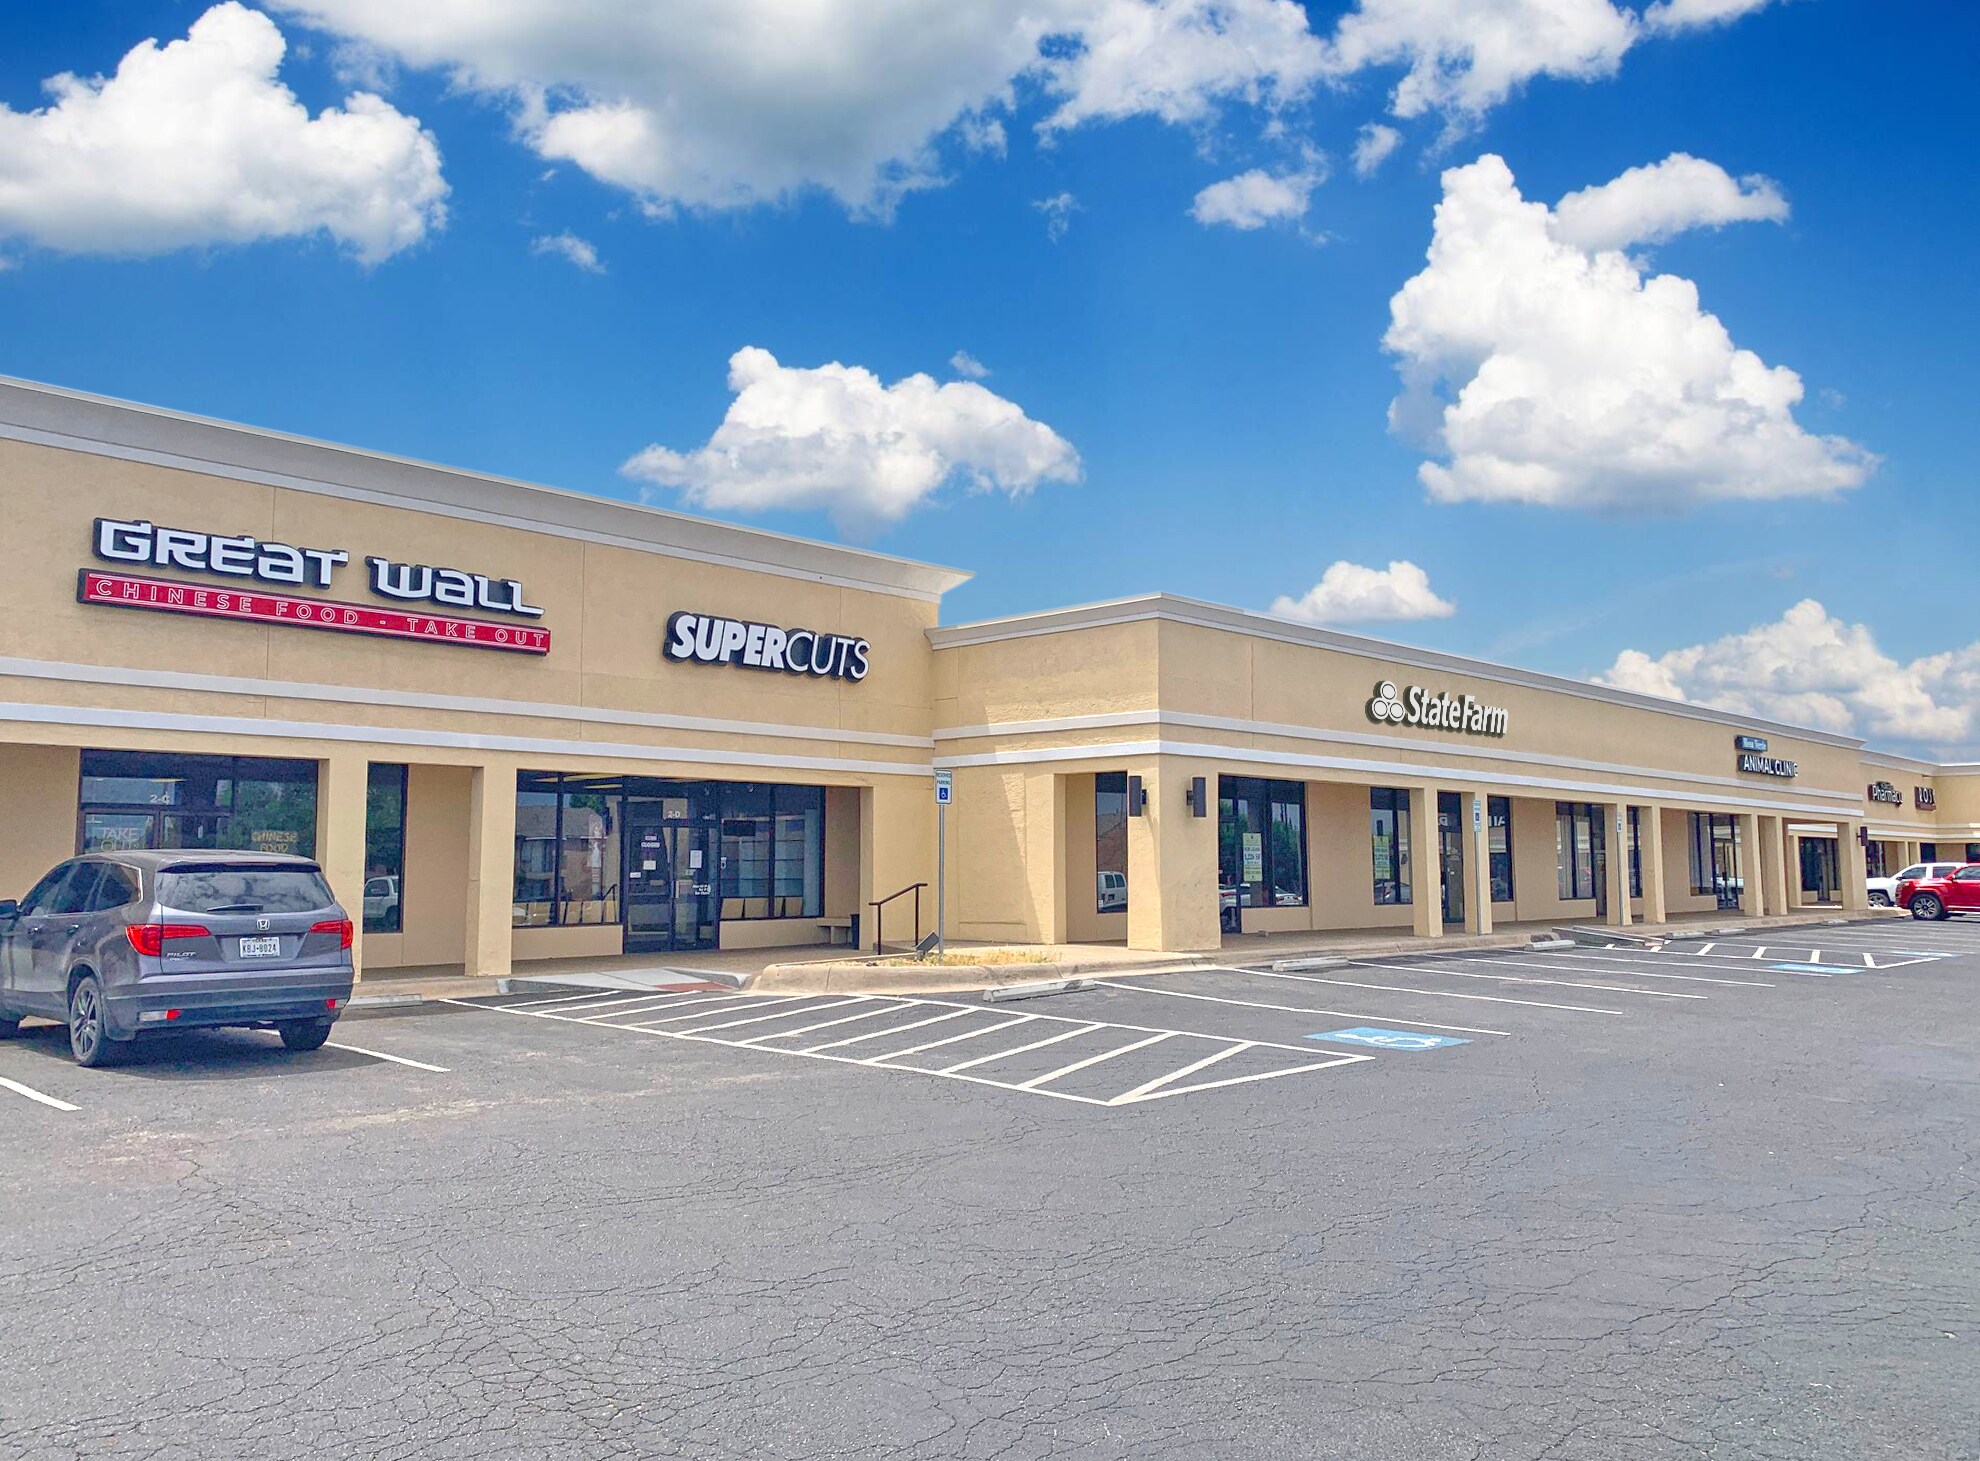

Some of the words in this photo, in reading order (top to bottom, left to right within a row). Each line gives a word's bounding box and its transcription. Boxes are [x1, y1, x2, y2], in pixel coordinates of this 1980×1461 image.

[96, 579, 252, 612] CHINESE
[275, 601, 358, 625] FOOD
[407, 617, 476, 639] TAKE
[495, 628, 544, 645] OUT
[670, 614, 871, 680] SUPERCUTS
[1744, 754, 1774, 775] ANIMAL
[1775, 759, 1799, 777] CLINIC
[1872, 784, 1904, 807] Pharmacy
[99, 827, 139, 842] TAKE
